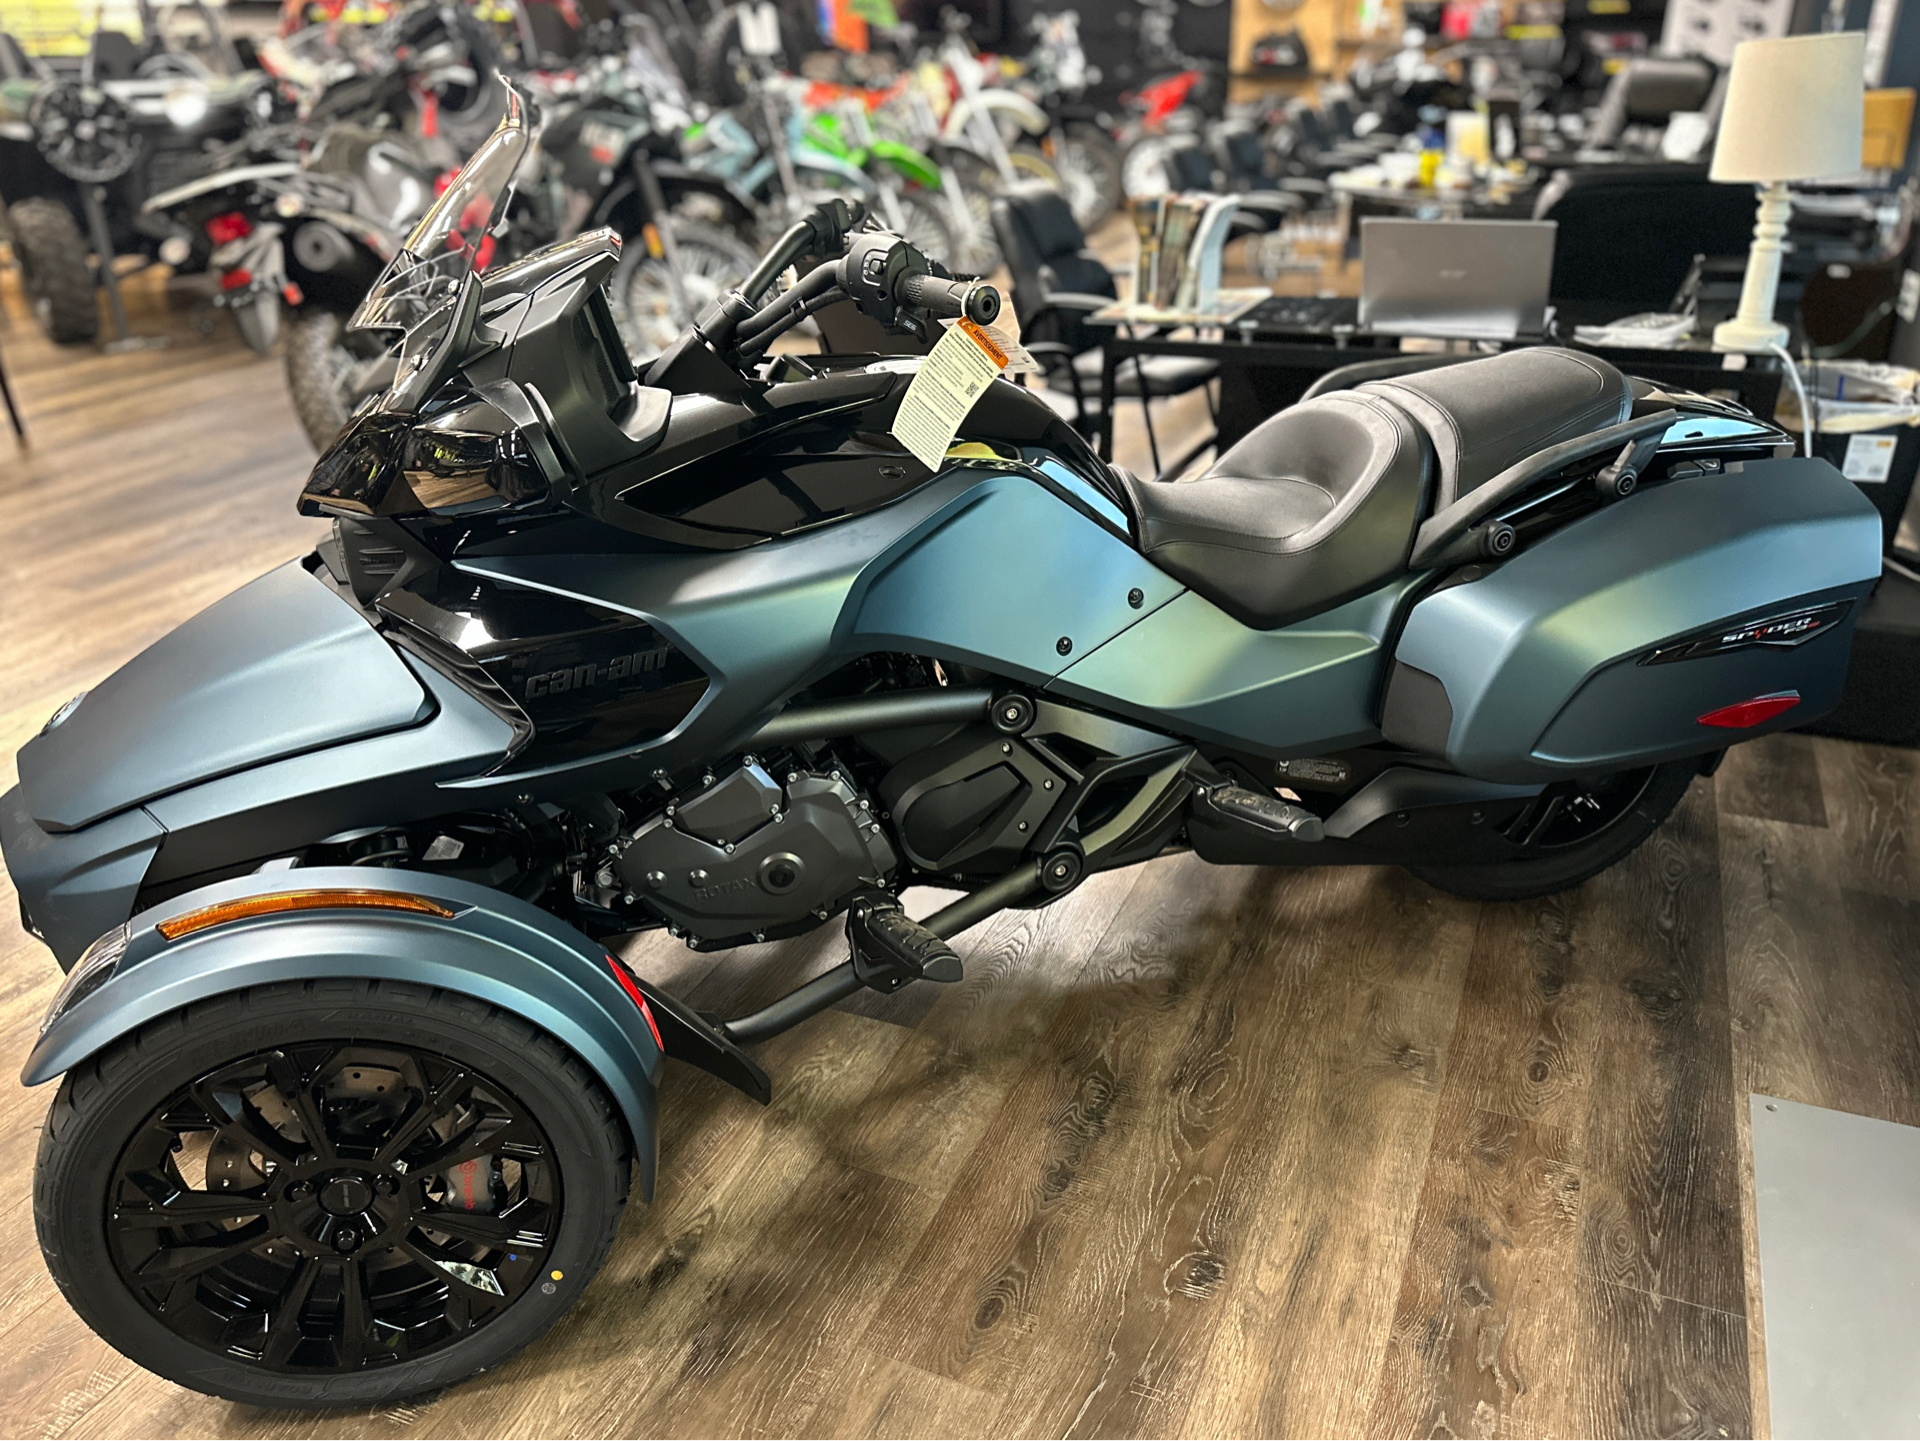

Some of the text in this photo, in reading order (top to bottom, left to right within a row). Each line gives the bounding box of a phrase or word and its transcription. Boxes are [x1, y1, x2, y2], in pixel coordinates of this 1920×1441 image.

[972, 329, 1003, 361] AVERTISSEMENT
[1721, 617, 1812, 643] SPYDER
[525, 647, 668, 700] can-am
[693, 876, 756, 902] ROTAX
[463, 1175, 476, 1210] bremb
